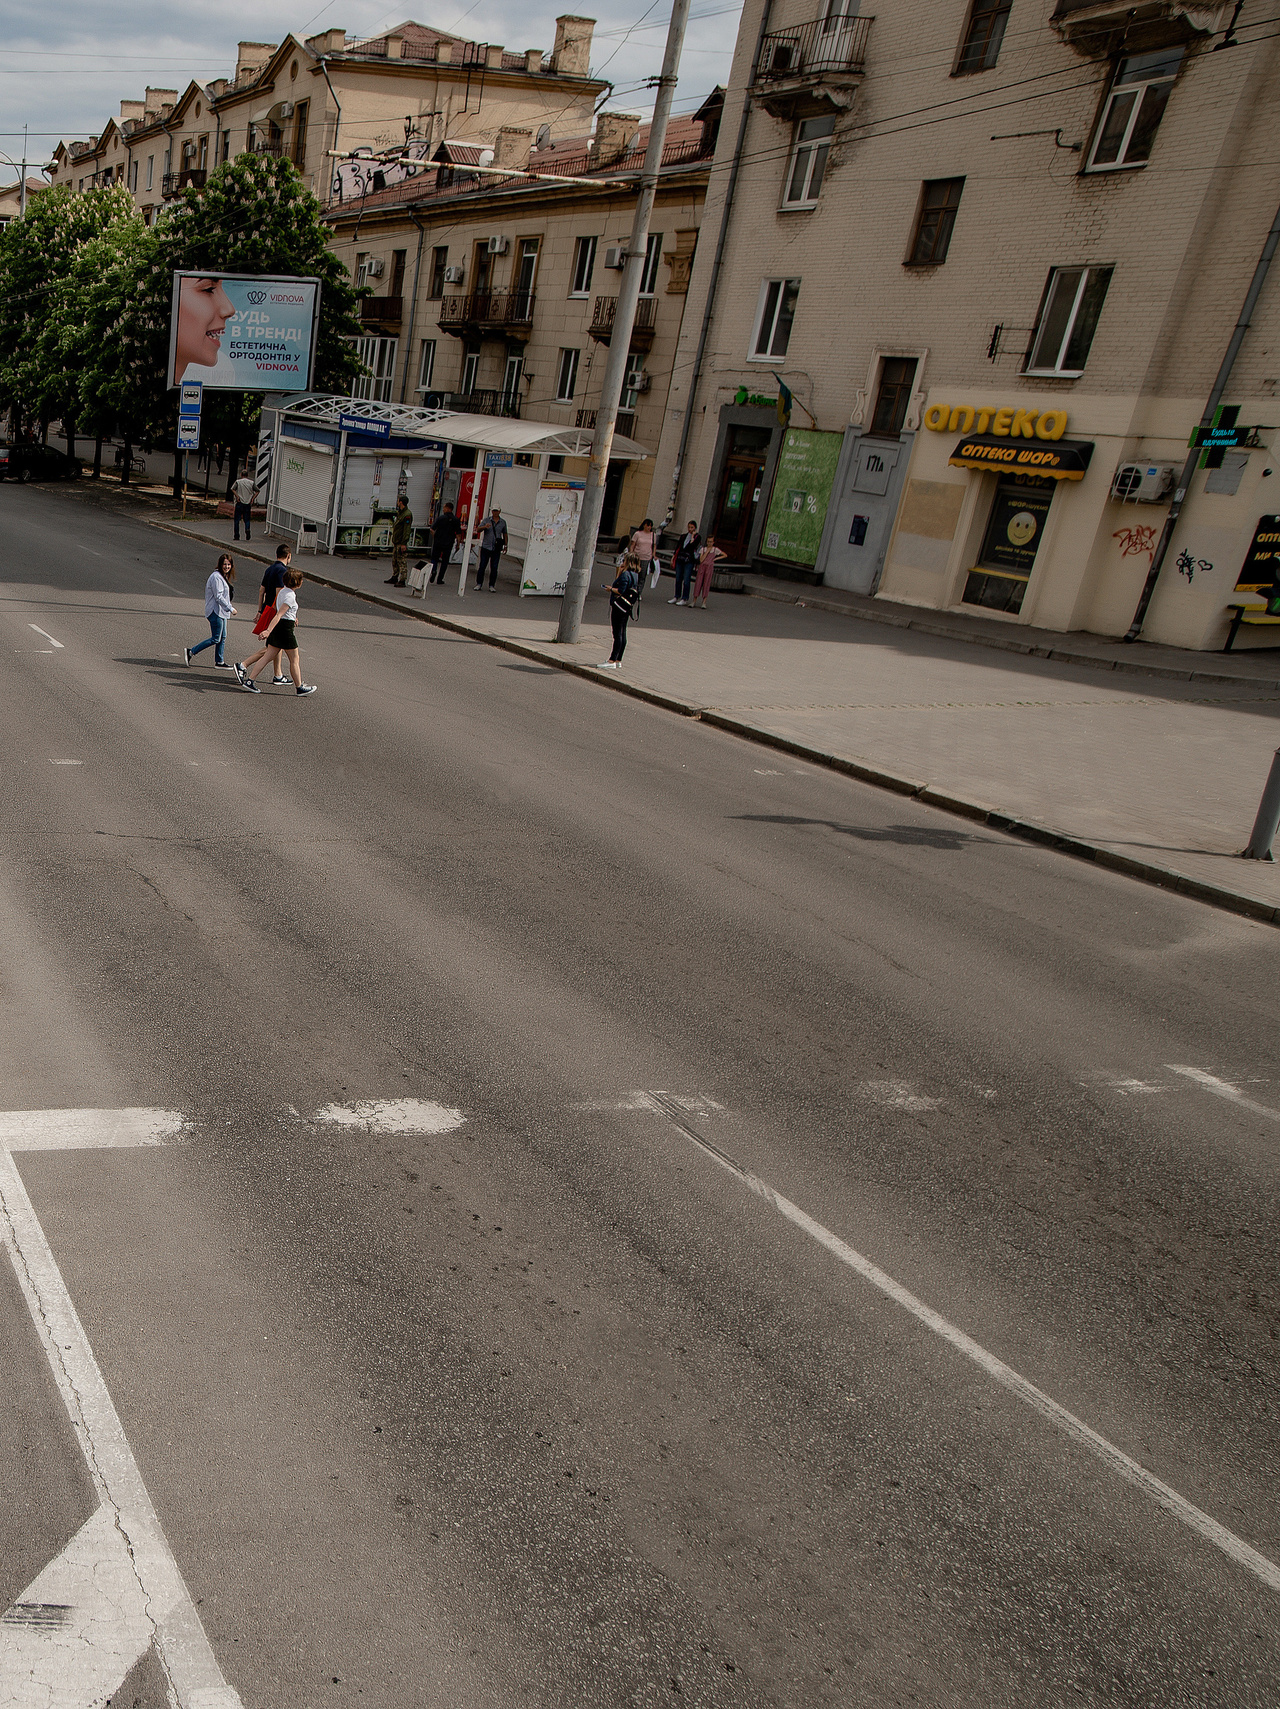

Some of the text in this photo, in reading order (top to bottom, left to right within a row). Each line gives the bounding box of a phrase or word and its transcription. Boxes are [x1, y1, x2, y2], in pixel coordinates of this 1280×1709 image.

[270, 293, 304, 303] VIDNOVA
[228, 311, 270, 325] БУДЬ
[231, 325, 302, 342] В ТРЕНДІ
[230, 341, 286, 351] ЕСТЕТИЧНА
[229, 351, 301, 362] ОРТОДОНТІЯ У
[256, 363, 299, 372] VIDNOVA
